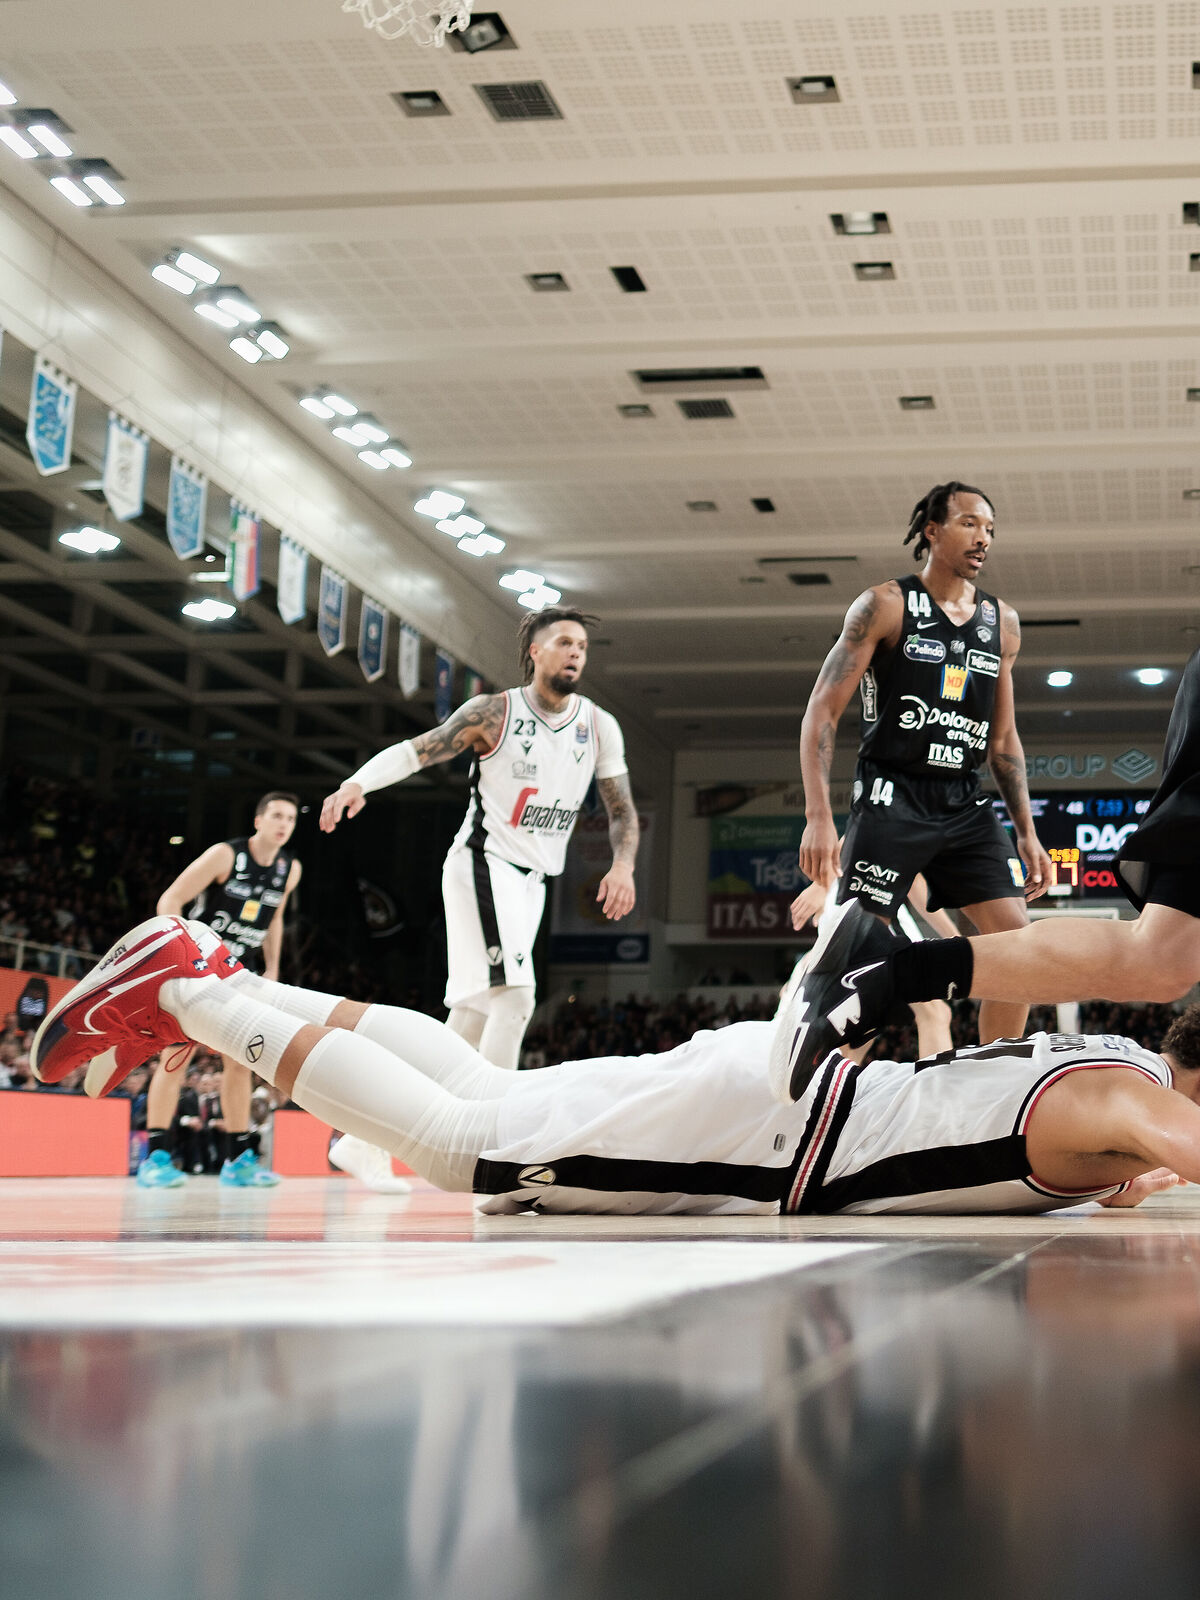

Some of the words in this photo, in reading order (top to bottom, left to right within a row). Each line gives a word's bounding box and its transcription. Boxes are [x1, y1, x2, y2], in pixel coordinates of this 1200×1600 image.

[908, 590, 932, 617] 44
[947, 675, 963, 688] MD
[514, 719, 536, 736] 23
[928, 743, 964, 764] ITAS
[869, 778, 894, 806] 44
[855, 861, 900, 883] CAVIT
[712, 903, 779, 928] ITAS
